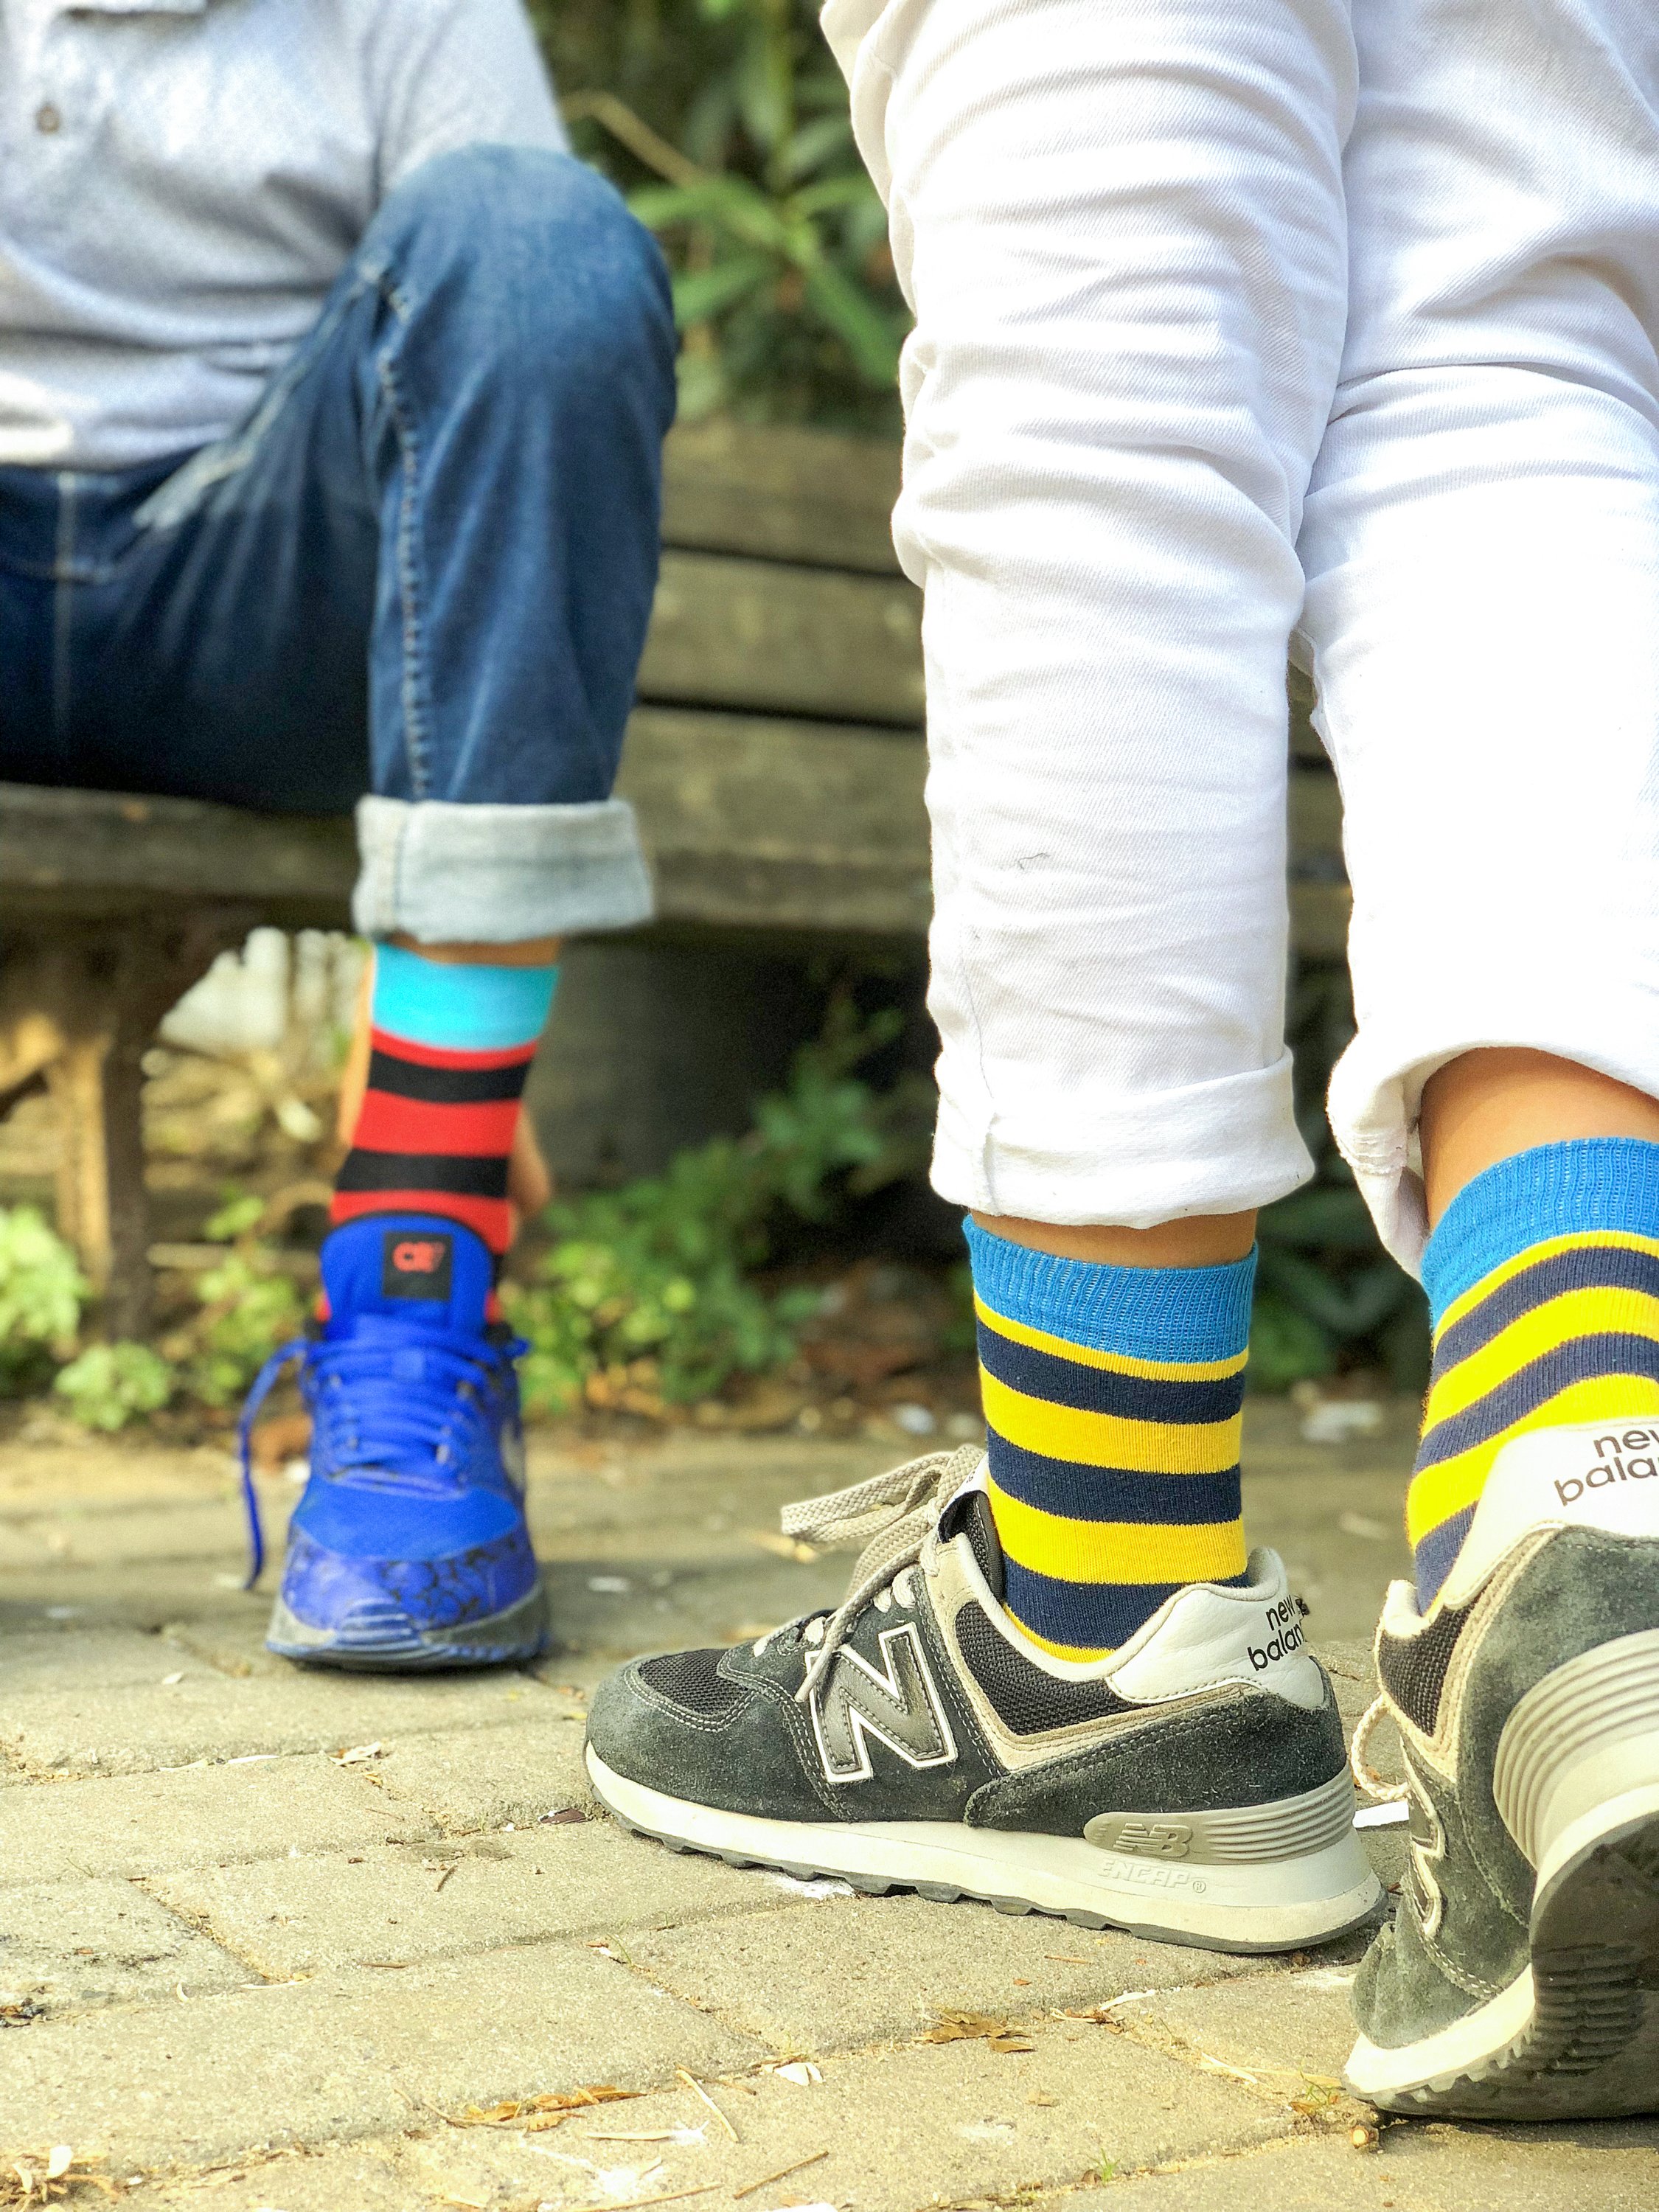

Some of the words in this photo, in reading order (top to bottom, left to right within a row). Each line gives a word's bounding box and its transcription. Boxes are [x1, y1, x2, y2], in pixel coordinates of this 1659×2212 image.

[1554, 1456, 1659, 1506] bala
[1265, 1594, 1295, 1631] new
[804, 1621, 959, 1784] N
[1113, 1823, 1192, 1857] NB
